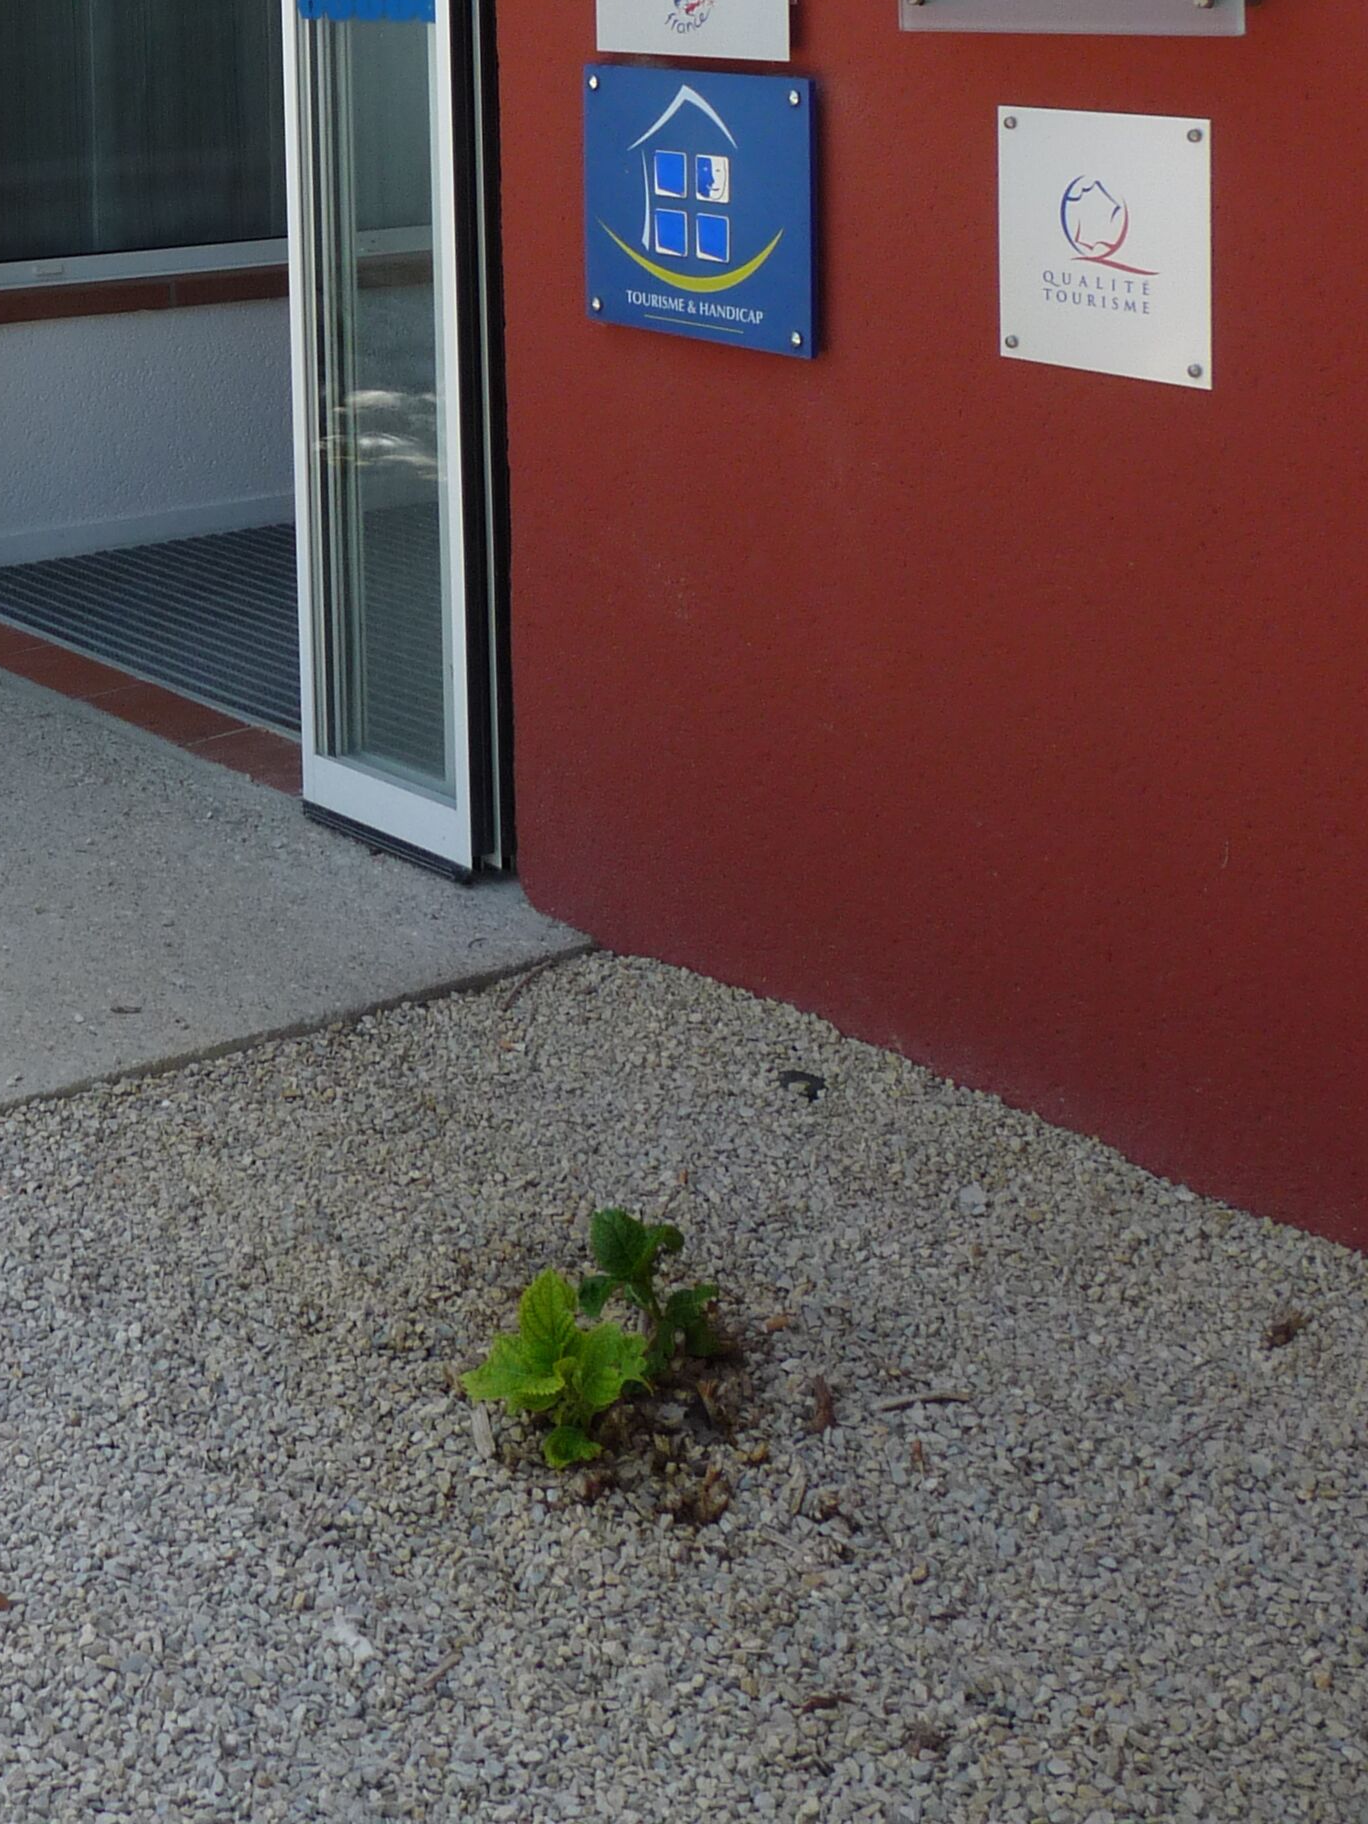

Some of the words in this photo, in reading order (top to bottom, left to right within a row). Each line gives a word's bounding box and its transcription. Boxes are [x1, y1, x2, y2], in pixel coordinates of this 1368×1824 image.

[1043, 270, 1151, 296] QUALITÉ
[626, 290, 685, 312] TOURISME
[687, 299, 696, 314] &
[699, 302, 764, 325] HANDICAP
[1043, 288, 1150, 315] TOURISME
